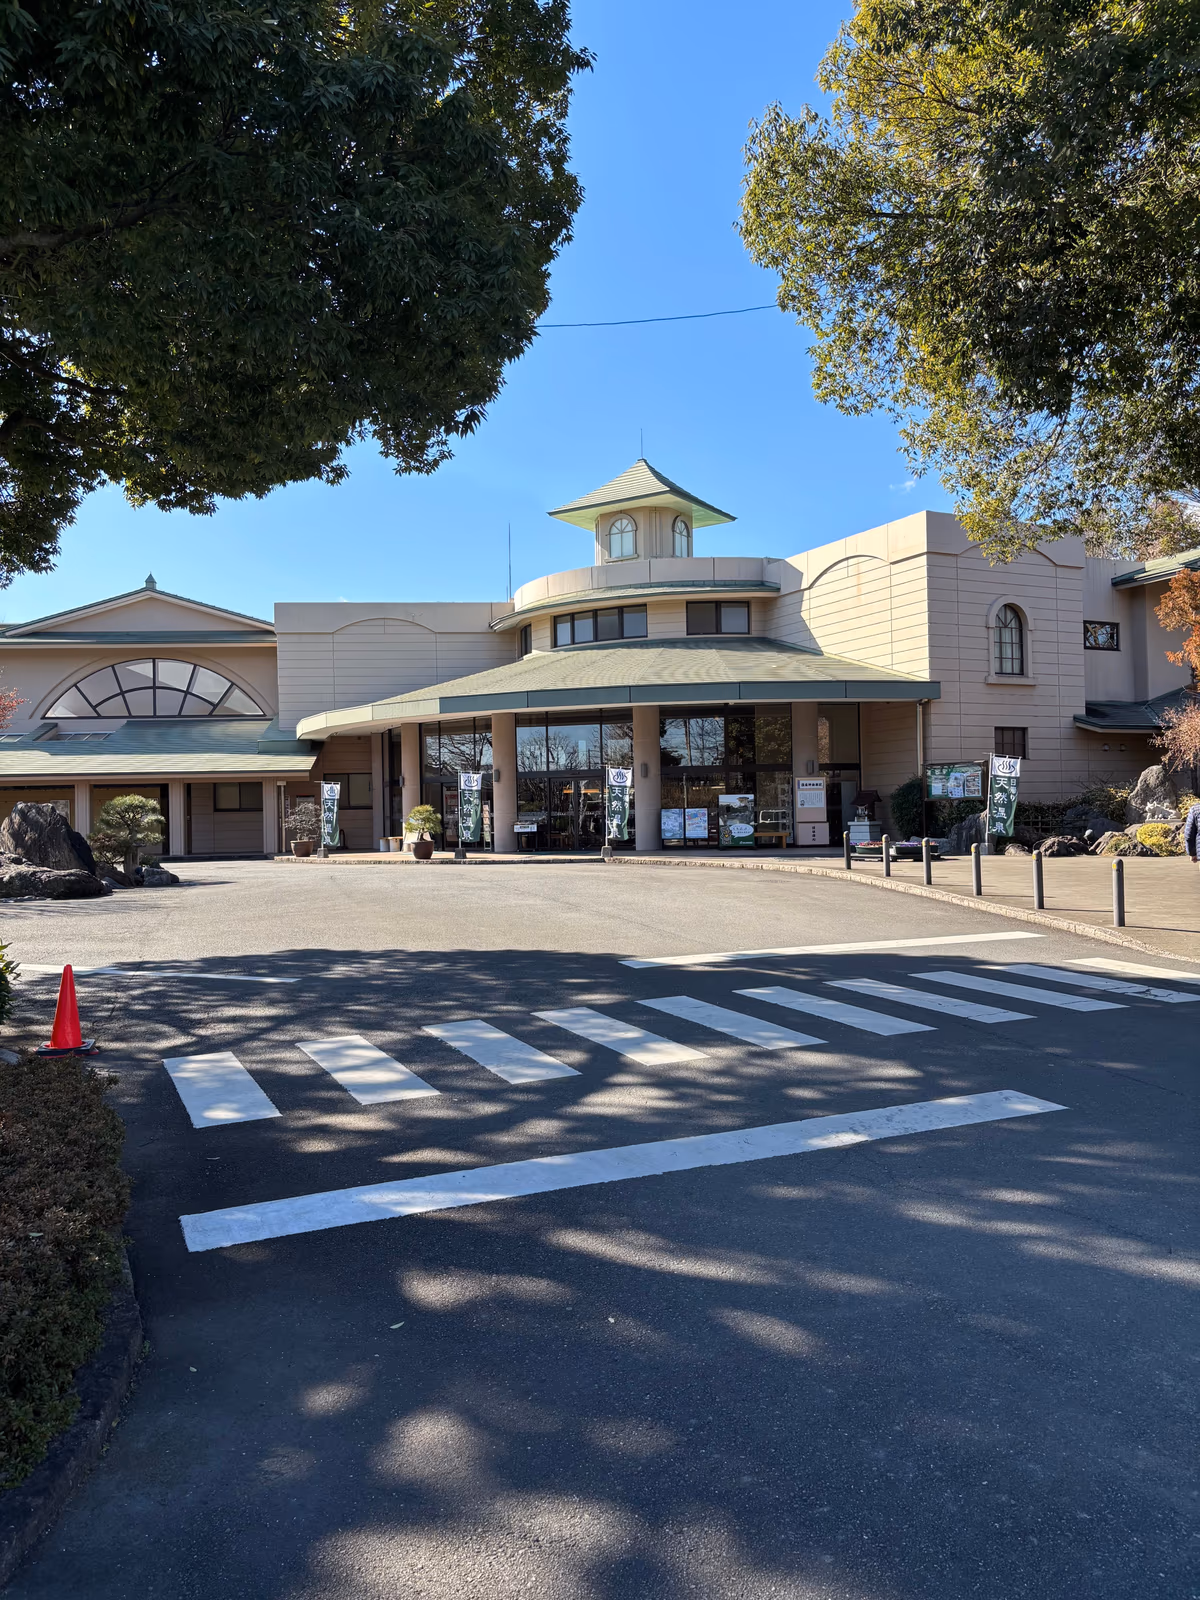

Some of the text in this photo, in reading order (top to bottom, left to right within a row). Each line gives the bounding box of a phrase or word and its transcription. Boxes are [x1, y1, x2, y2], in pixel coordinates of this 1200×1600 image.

[461, 791, 474, 840] 天然温泉
[992, 777, 1009, 834] 天然温泉
